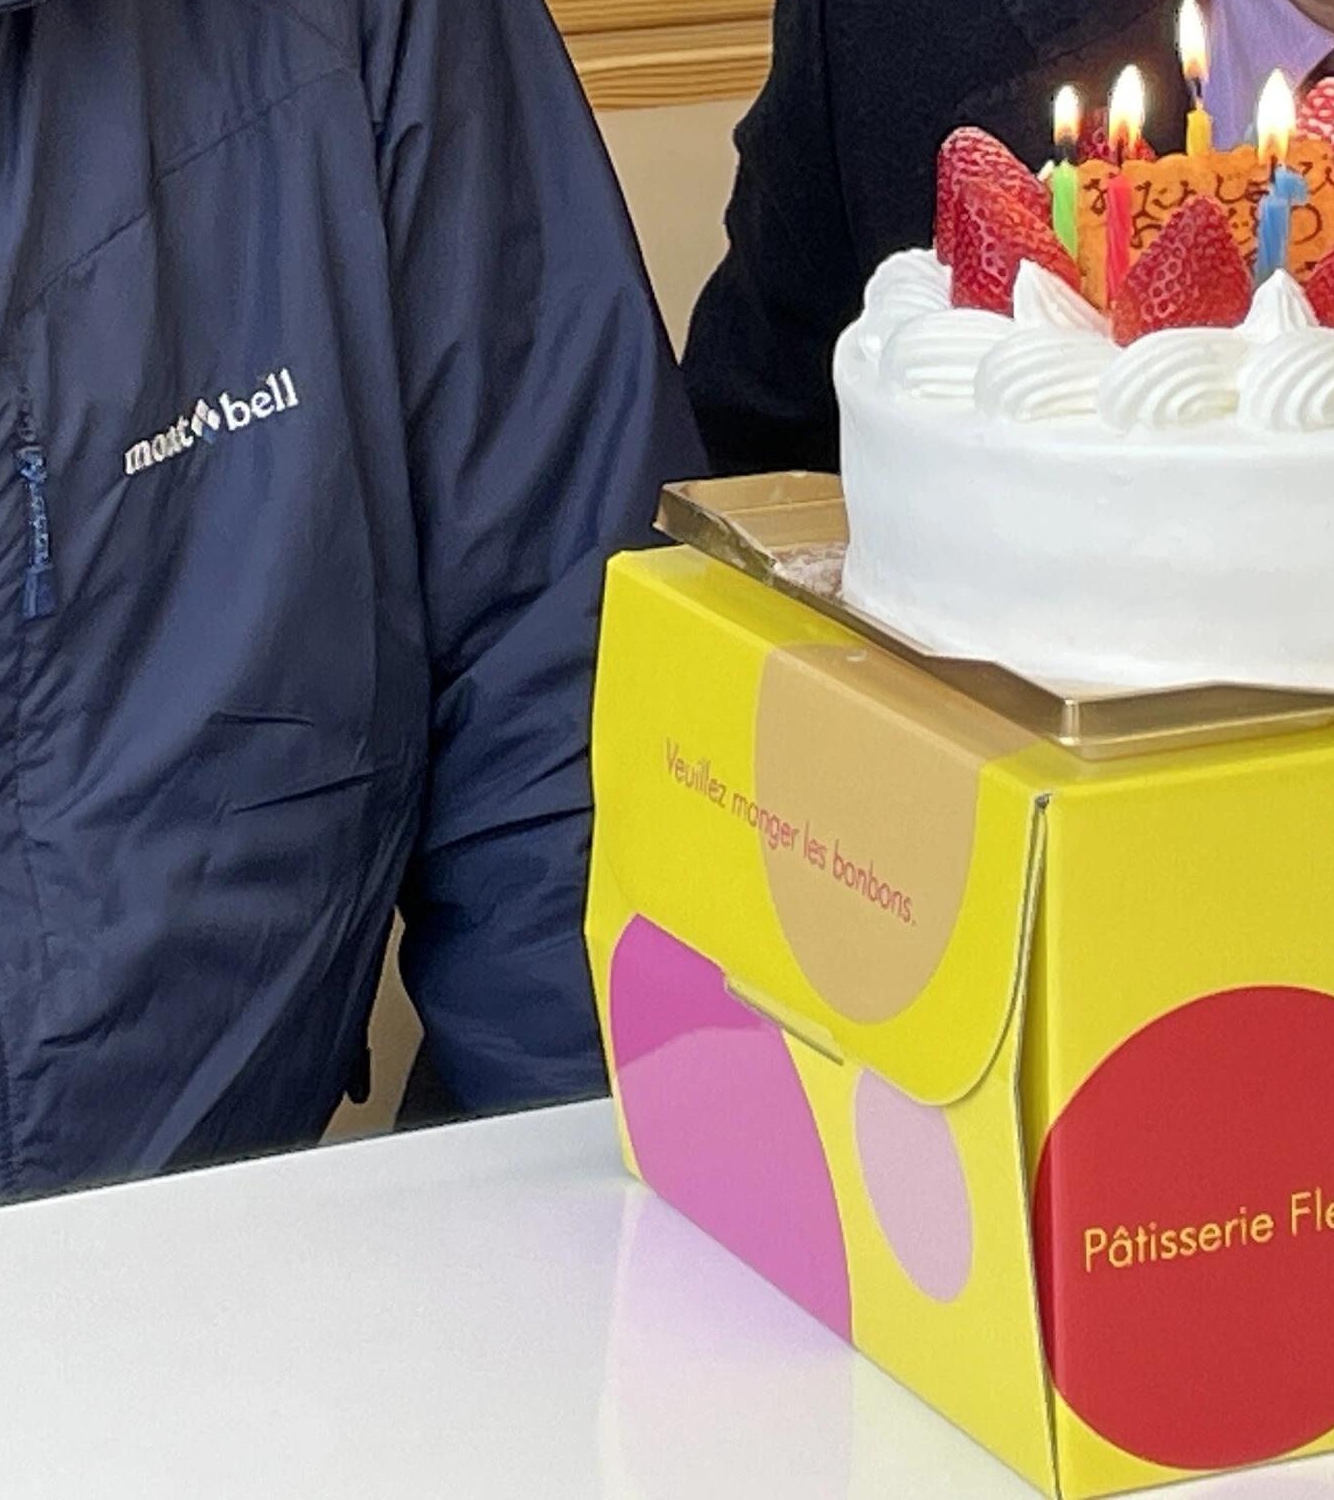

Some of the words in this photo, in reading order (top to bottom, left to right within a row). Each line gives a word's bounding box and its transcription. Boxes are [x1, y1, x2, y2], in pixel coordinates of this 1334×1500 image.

[665, 736, 727, 809] Veuillez
[802, 819, 828, 871] les
[832, 838, 917, 927] bonbons.
[1083, 1205, 1276, 1274] Pâtisserie
